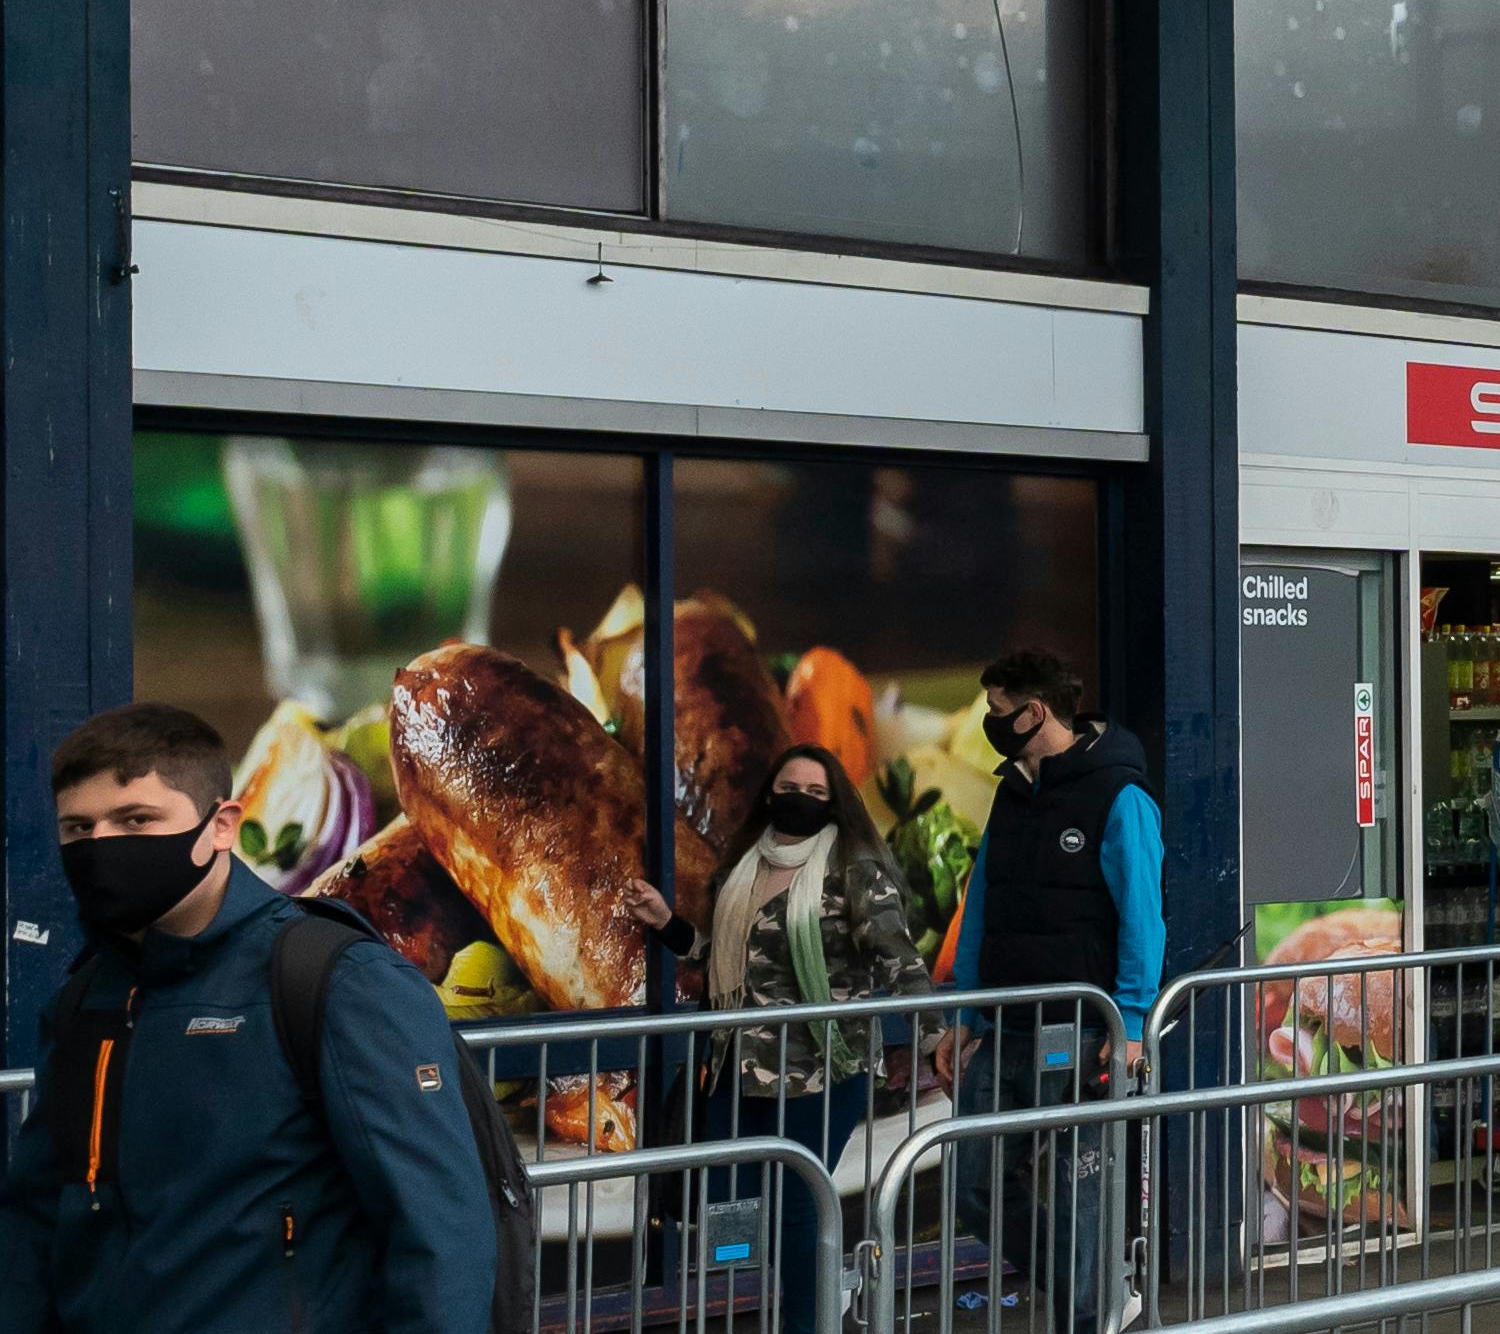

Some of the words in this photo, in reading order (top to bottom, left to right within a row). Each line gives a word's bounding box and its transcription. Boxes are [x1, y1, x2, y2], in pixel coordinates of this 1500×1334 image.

[1242, 575, 1308, 601] Chilled
[1242, 604, 1308, 627] snacks
[1359, 718, 1371, 799] SPAR
